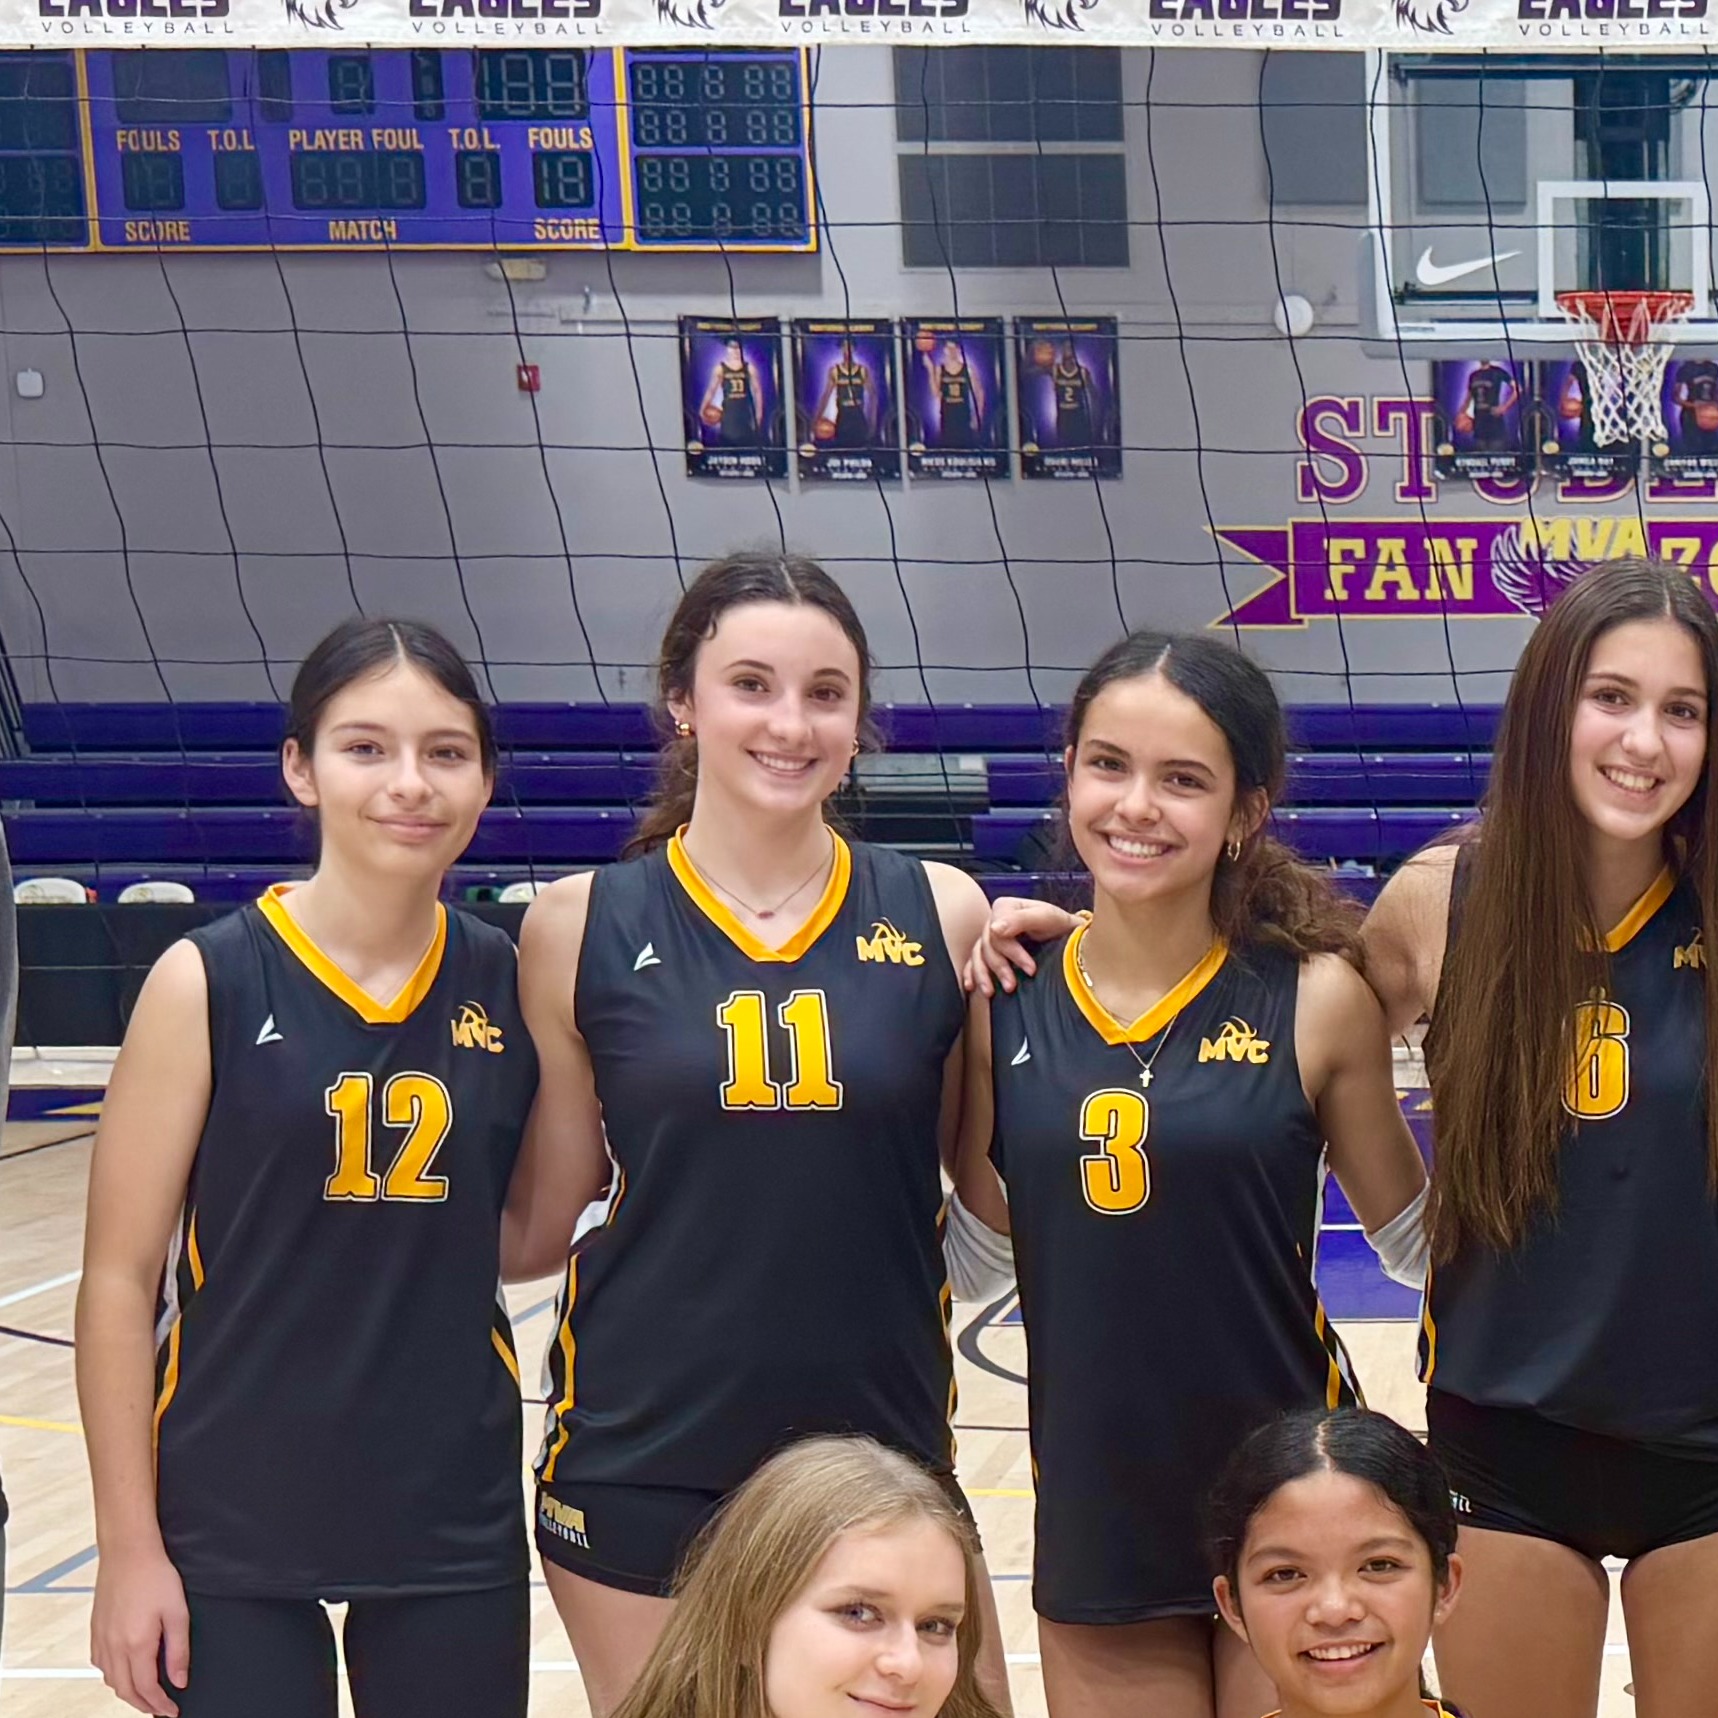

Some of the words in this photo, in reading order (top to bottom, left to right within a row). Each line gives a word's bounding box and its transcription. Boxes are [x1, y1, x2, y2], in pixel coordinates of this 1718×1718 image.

[42, 20, 234, 36] VOLLEYBALL
[411, 20, 603, 36] VOLLEYBALL
[780, 19, 971, 34] VOLLEYBALL
[1150, 20, 1344, 38] VOLLEYBALL
[1518, 21, 1710, 36] VOLLEYBALL
[116, 131, 180, 152] FOULS
[289, 131, 363, 151] PLAYER
[372, 130, 423, 150] FOUL
[528, 127, 593, 150] FOULS
[125, 220, 190, 242] SCORE
[329, 220, 397, 241] MATCH
[534, 218, 600, 240] SCORE
[1324, 537, 1478, 601] FAN
[856, 936, 925, 966] MVC
[451, 1019, 505, 1055] MVC
[714, 988, 845, 1112] 11
[1198, 1037, 1270, 1064] MVC
[1561, 1001, 1630, 1120] 6
[323, 1070, 454, 1203] 12
[1078, 1086, 1152, 1216] 3
